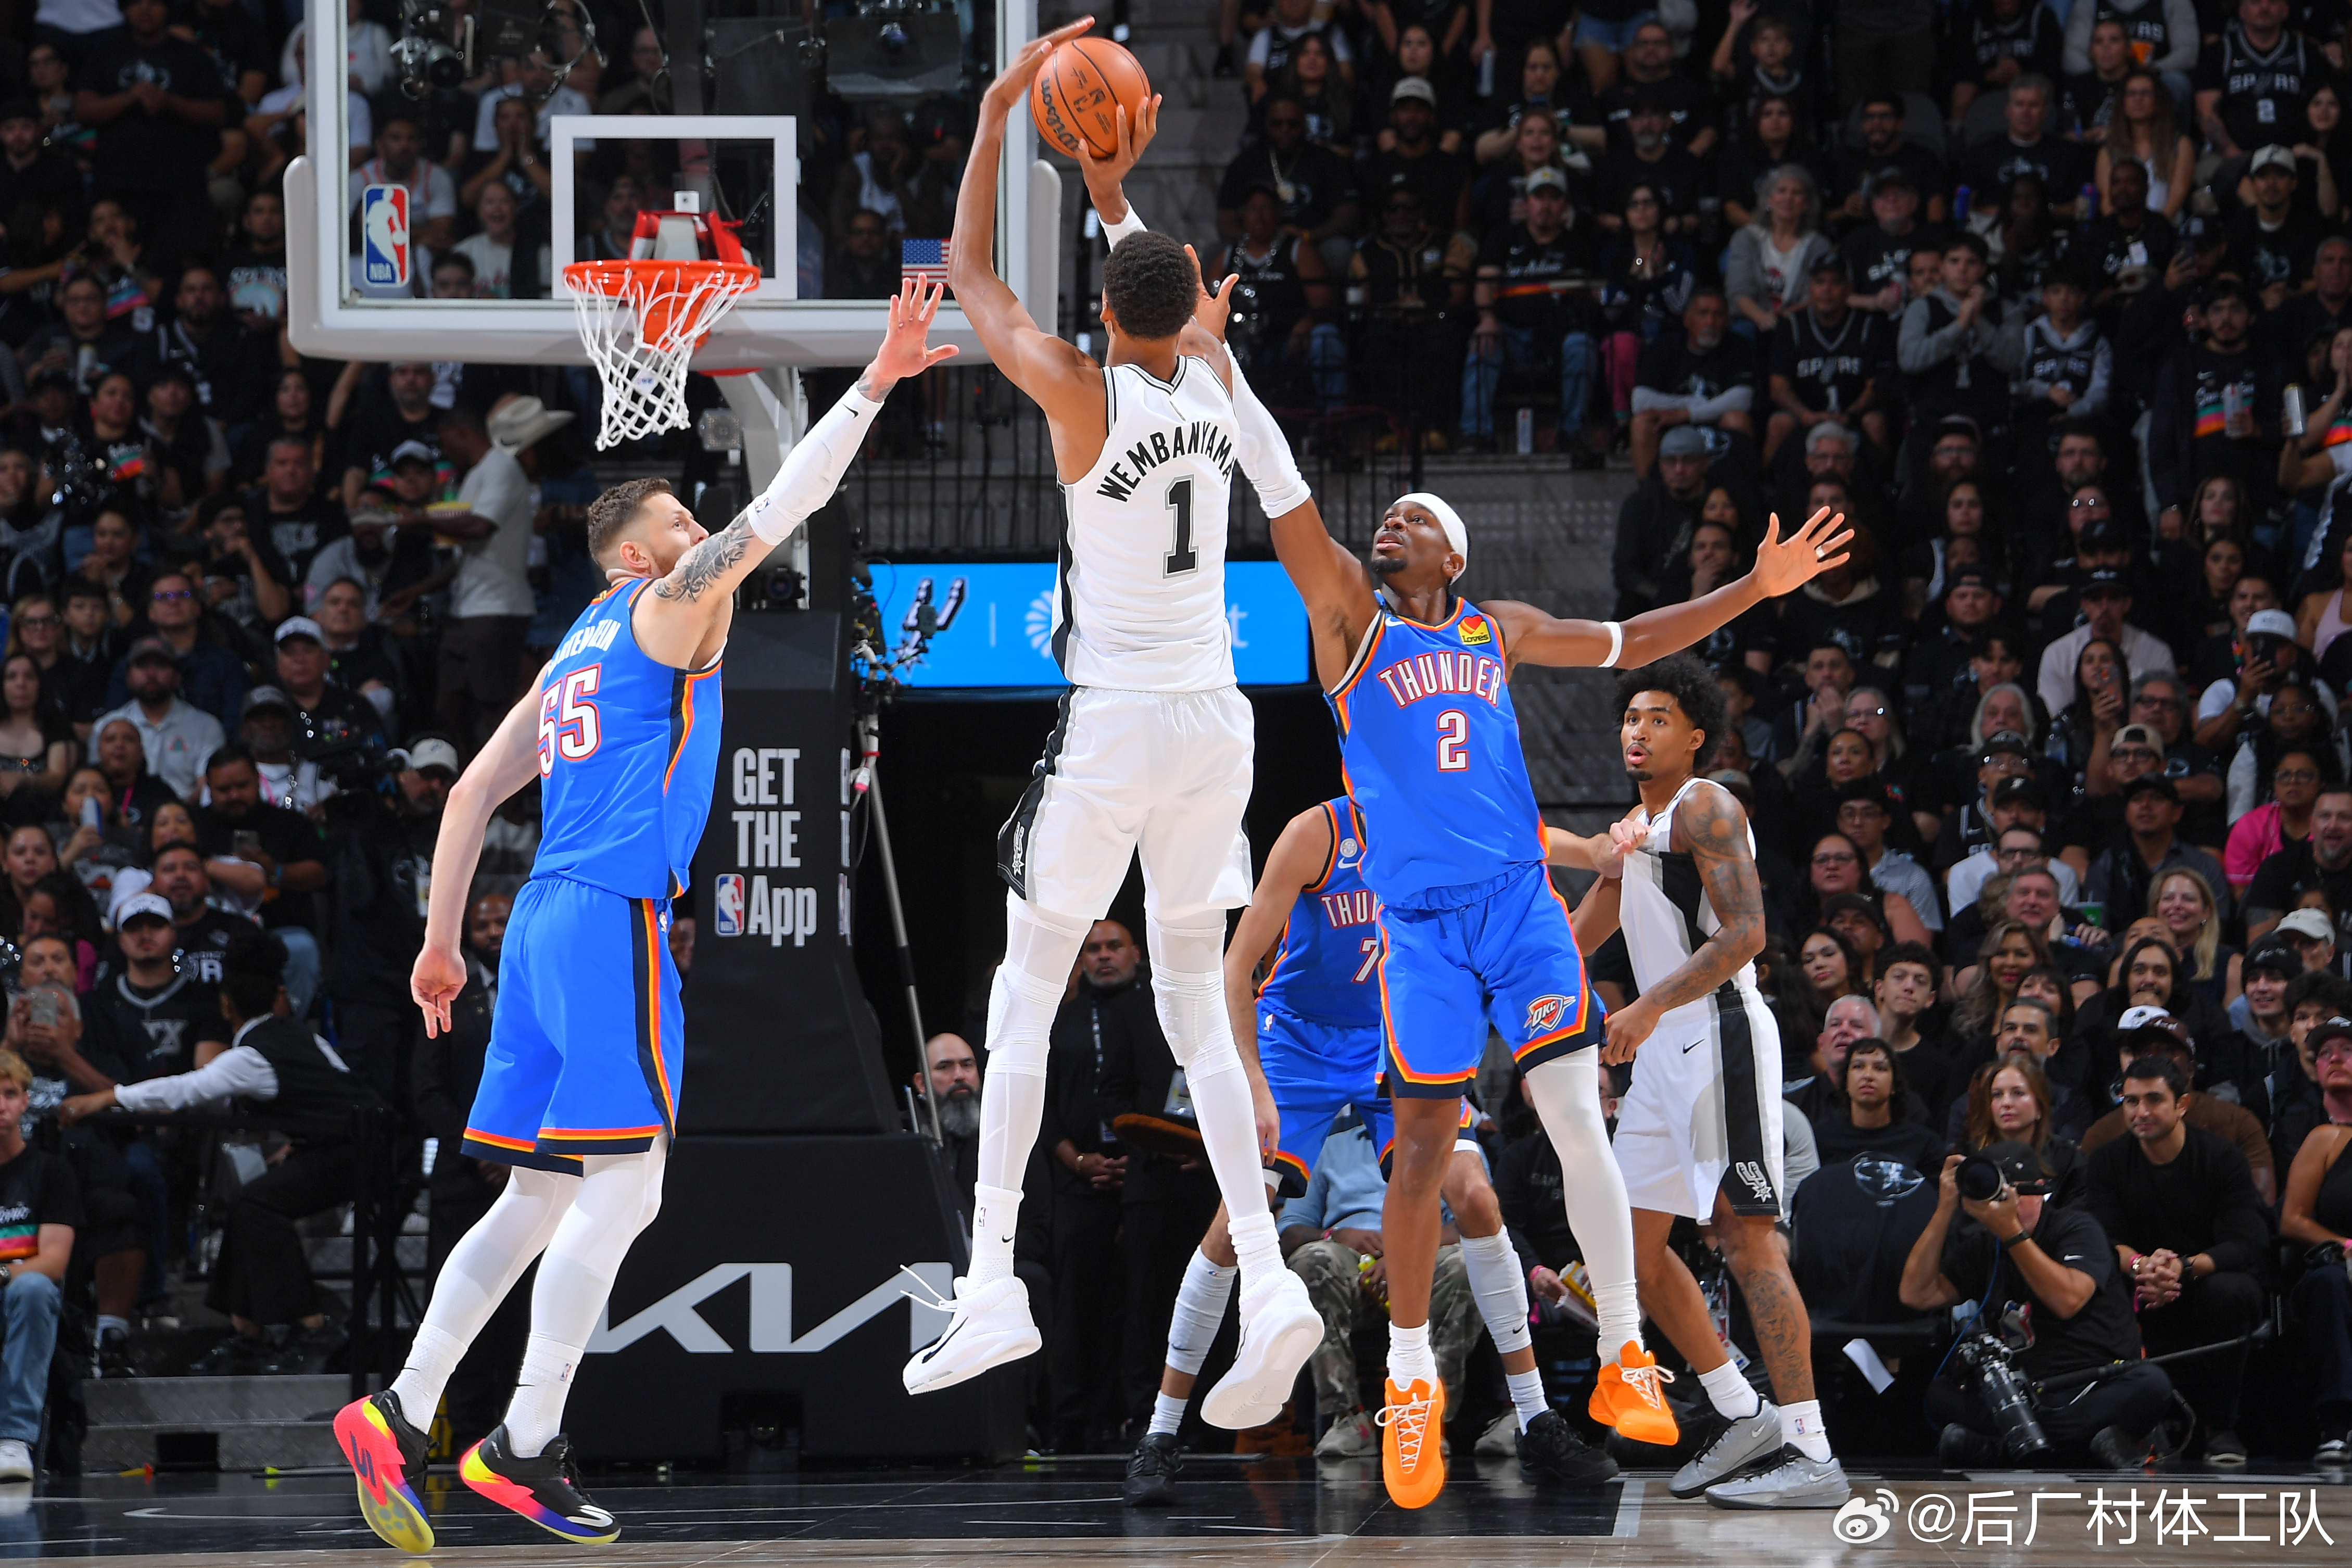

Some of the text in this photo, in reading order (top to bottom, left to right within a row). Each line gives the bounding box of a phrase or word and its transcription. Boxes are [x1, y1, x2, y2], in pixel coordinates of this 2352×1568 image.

[370, 262, 392, 281] NBA
[1096, 421, 1233, 503] WEMBANYAMA
[1162, 474, 1199, 579] 1
[1377, 651, 1502, 709] THUNDER
[538, 663, 601, 779] 55
[1437, 709, 1469, 772] 2
[732, 747, 801, 806] GET
[731, 810, 802, 868] THE
[747, 875, 817, 947] App
[1351, 937, 1380, 984] 7
[1531, 1000, 1556, 1028] OKC
